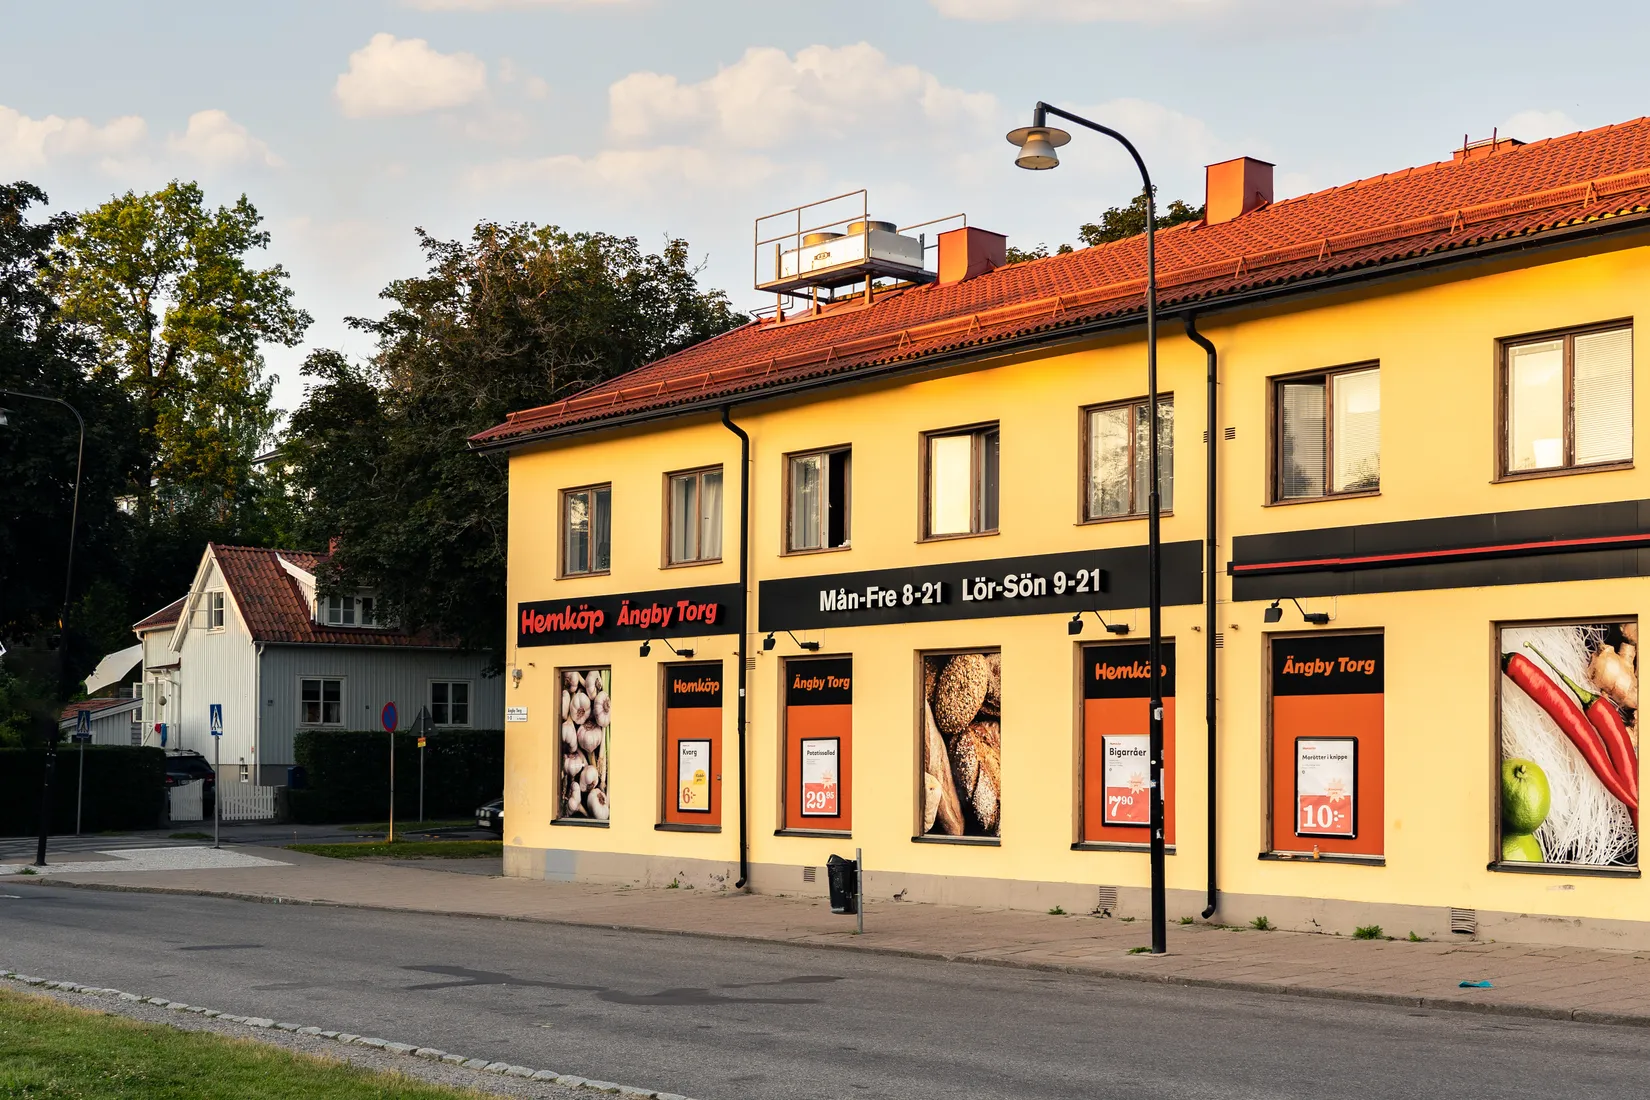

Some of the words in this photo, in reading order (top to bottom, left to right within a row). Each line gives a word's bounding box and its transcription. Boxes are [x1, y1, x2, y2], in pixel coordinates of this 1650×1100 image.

[819, 586, 897, 611] Mån-Fre
[902, 582, 942, 606] 8-21
[962, 573, 1047, 601] Lör-Sön
[1053, 569, 1101, 595] 9-21
[521, 604, 604, 634] Hemköp
[616, 600, 673, 629] Ängby
[676, 600, 717, 625] Torg
[1282, 655, 1335, 677] Ängby
[1338, 657, 1376, 675] Torg
[673, 677, 720, 695] Hemköp
[793, 674, 826, 691] Ängby
[827, 676, 850, 690] Torg
[682, 748, 698, 757] Kvarg
[1109, 747, 1147, 758] Bigarråer
[1329, 753, 1348, 761] knippe
[806, 790, 826, 809] 29
